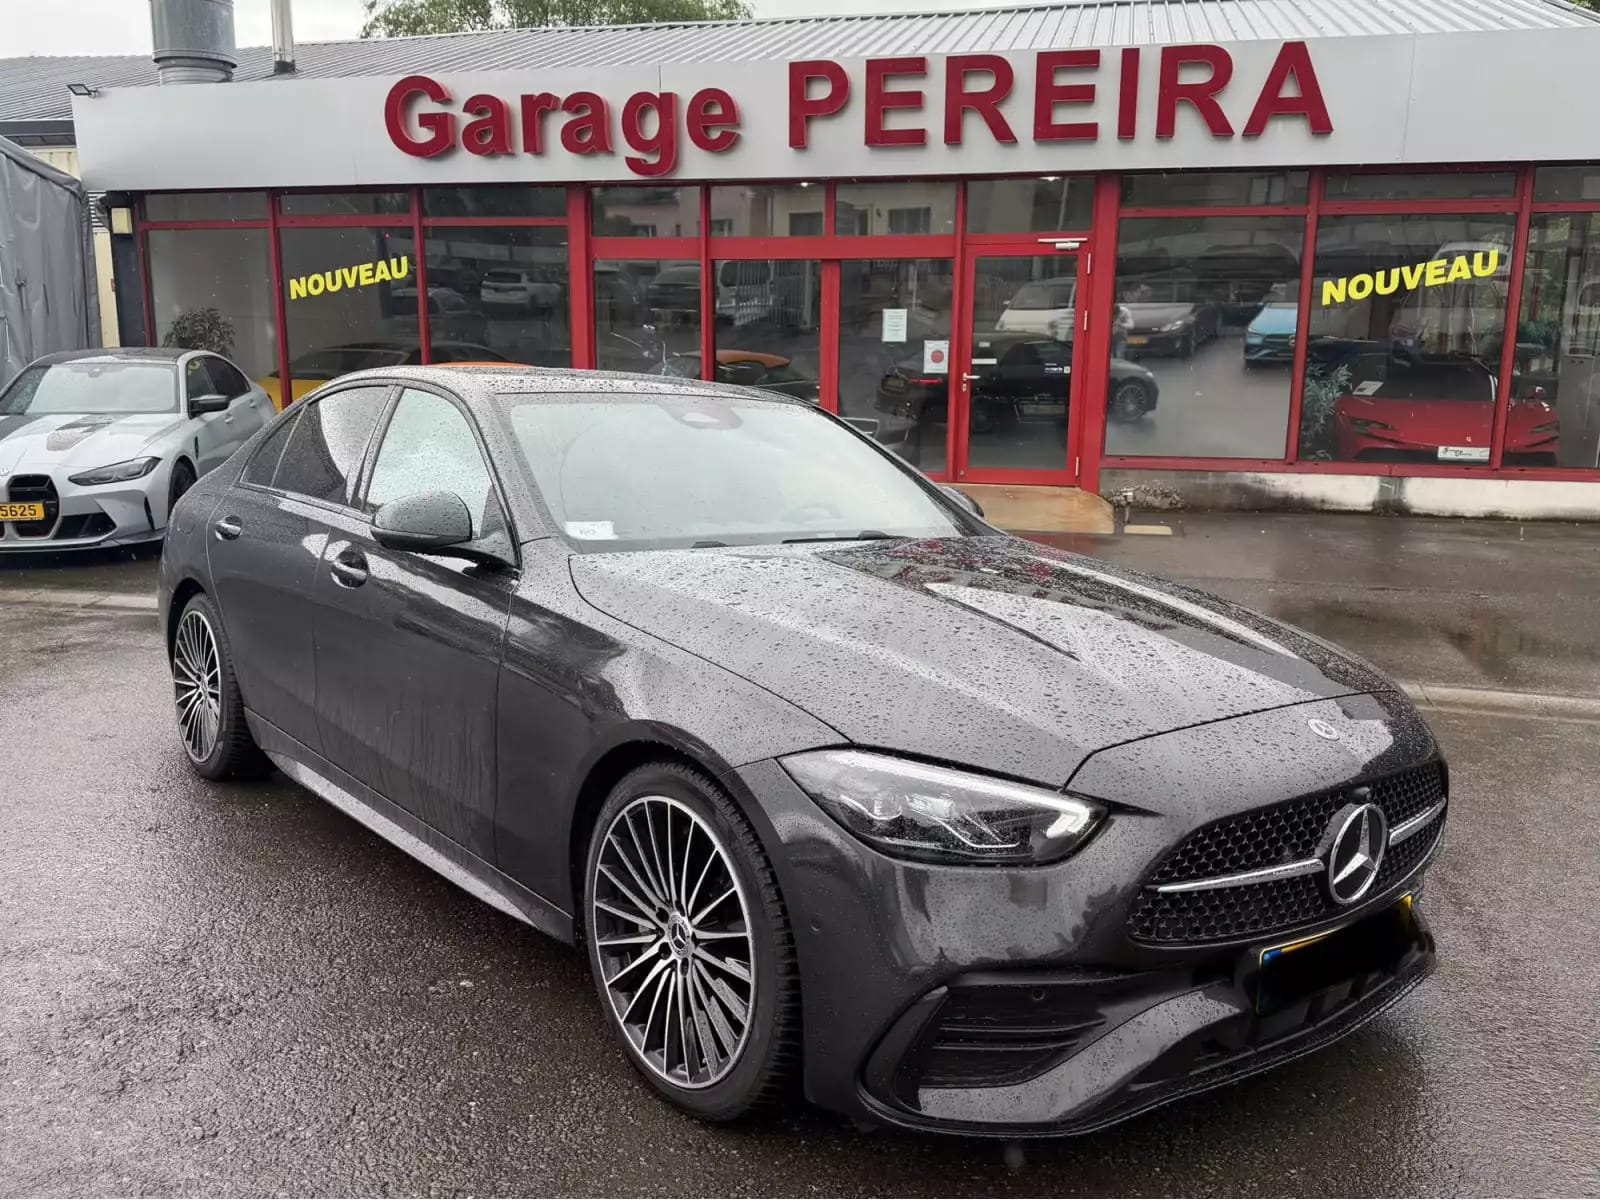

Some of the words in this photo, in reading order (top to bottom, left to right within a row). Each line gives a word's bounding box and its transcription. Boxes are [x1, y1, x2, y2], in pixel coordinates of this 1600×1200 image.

[385, 75, 741, 177] Garage
[789, 41, 1334, 150] PEREIRA
[289, 256, 409, 301] NOUVEAU
[1320, 248, 1500, 307] NOUVEAU
